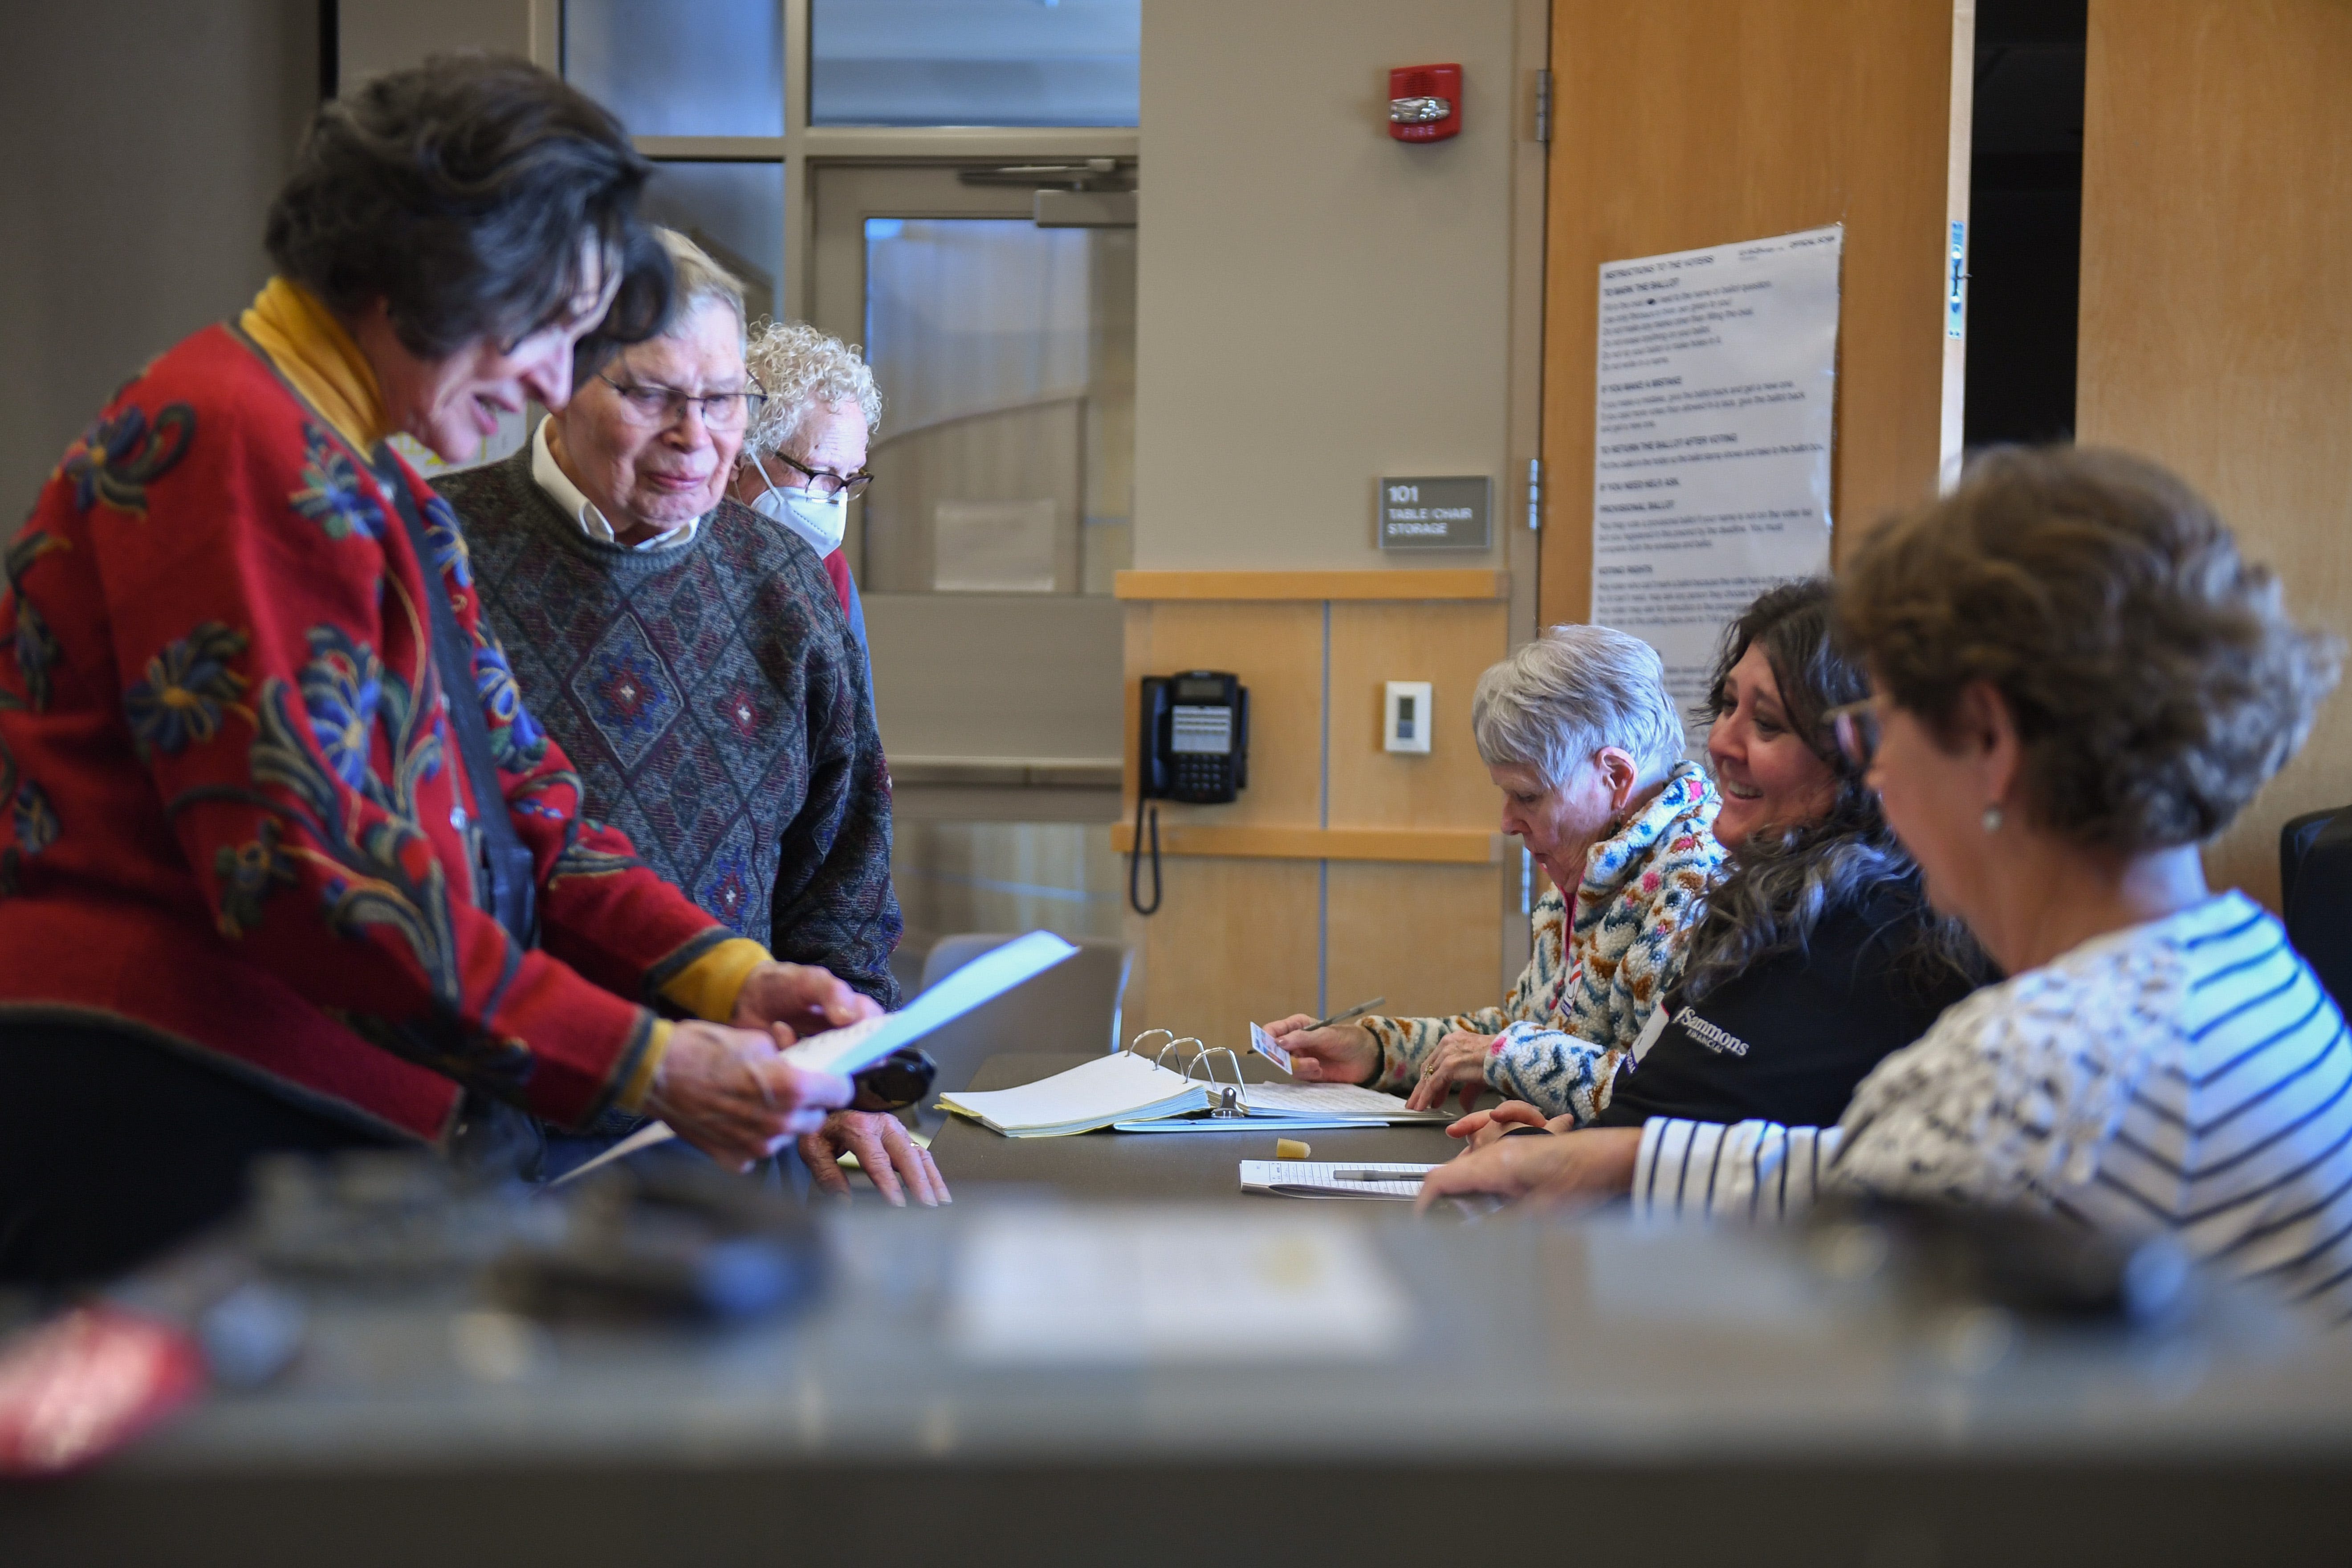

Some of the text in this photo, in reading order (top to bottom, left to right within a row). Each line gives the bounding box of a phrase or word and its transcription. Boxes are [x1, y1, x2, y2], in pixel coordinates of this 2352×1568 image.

[1404, 125, 1435, 136] FIRE
[1650, 277, 1680, 290] BALLOT
[1388, 485, 1418, 503] 101
[1647, 501, 1675, 510] BALLOT
[1388, 508, 1473, 519] TABLE CHAIR
[1388, 522, 1448, 535] STORAGE
